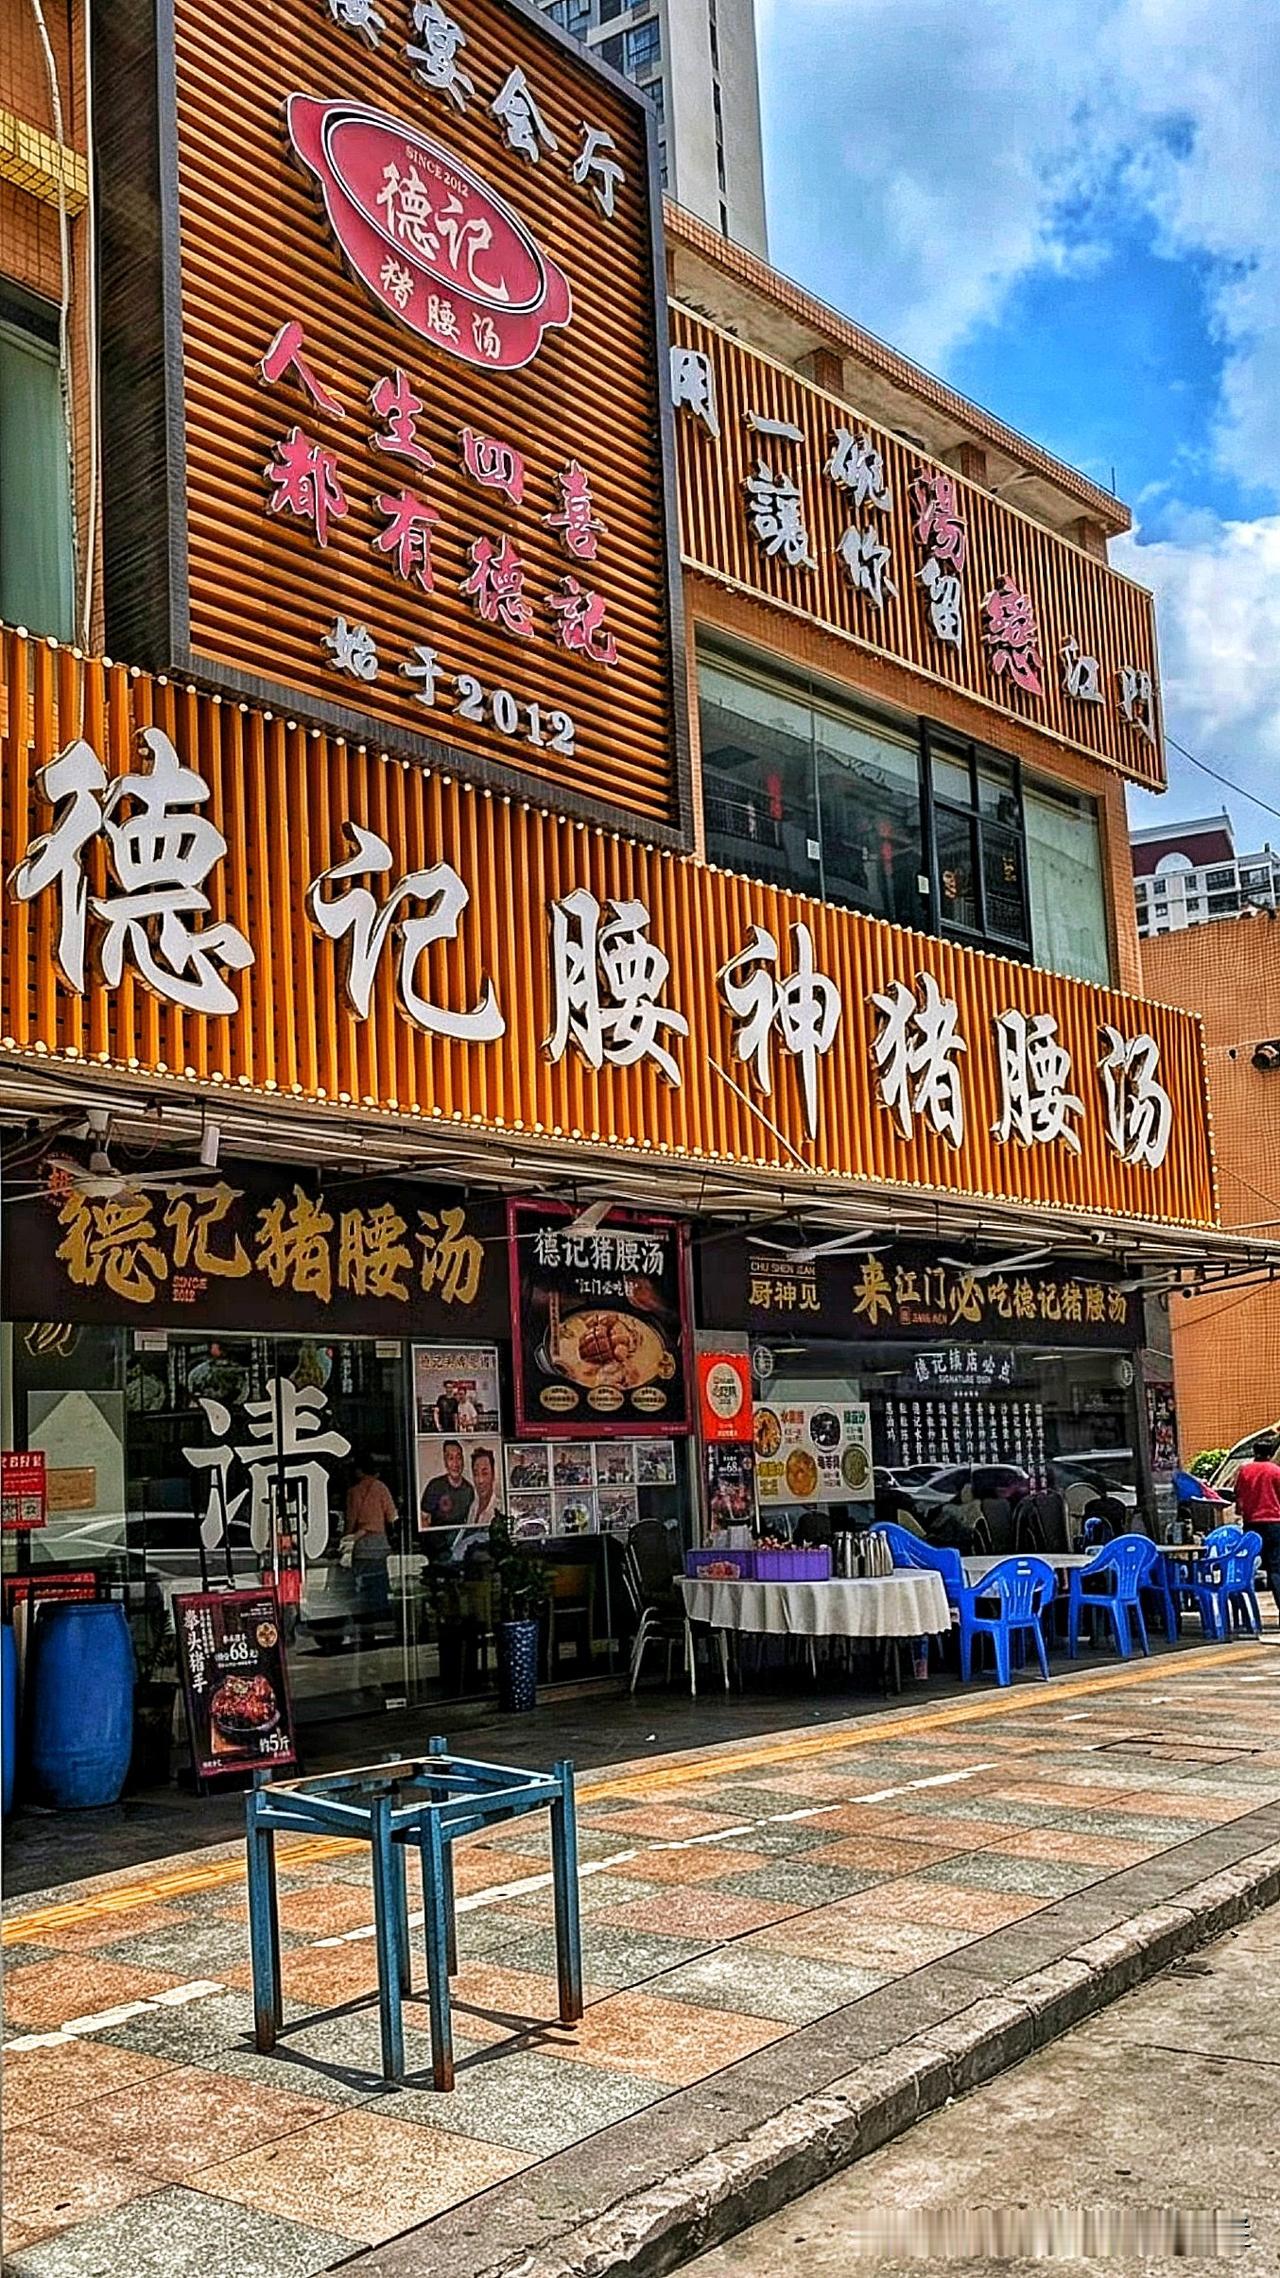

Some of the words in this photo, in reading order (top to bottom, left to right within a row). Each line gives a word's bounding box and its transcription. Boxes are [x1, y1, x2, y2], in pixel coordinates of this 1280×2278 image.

[405, 144, 443, 181] SINCE
[442, 171, 470, 198] 2012
[376, 160, 510, 302] 德记
[380, 254, 501, 360] 猪腰汤
[258, 320, 608, 560] 人生四喜
[8, 726, 1173, 1172] 德记腰神猪腰汤
[55, 1178, 485, 1304] 德记猪腰汤
[533, 1227, 665, 1276] 德记猪腰汤
[750, 1261, 769, 1273] CHU
[172, 1275, 208, 1290] SINCE
[172, 1289, 197, 1302] 2012
[749, 1279, 821, 1312] 厨神见
[852, 1251, 1128, 1327] 来江门必吃德记猪腰汤
[914, 1347, 1011, 1385] 德记镇店必点
[181, 1376, 352, 1561] 请
